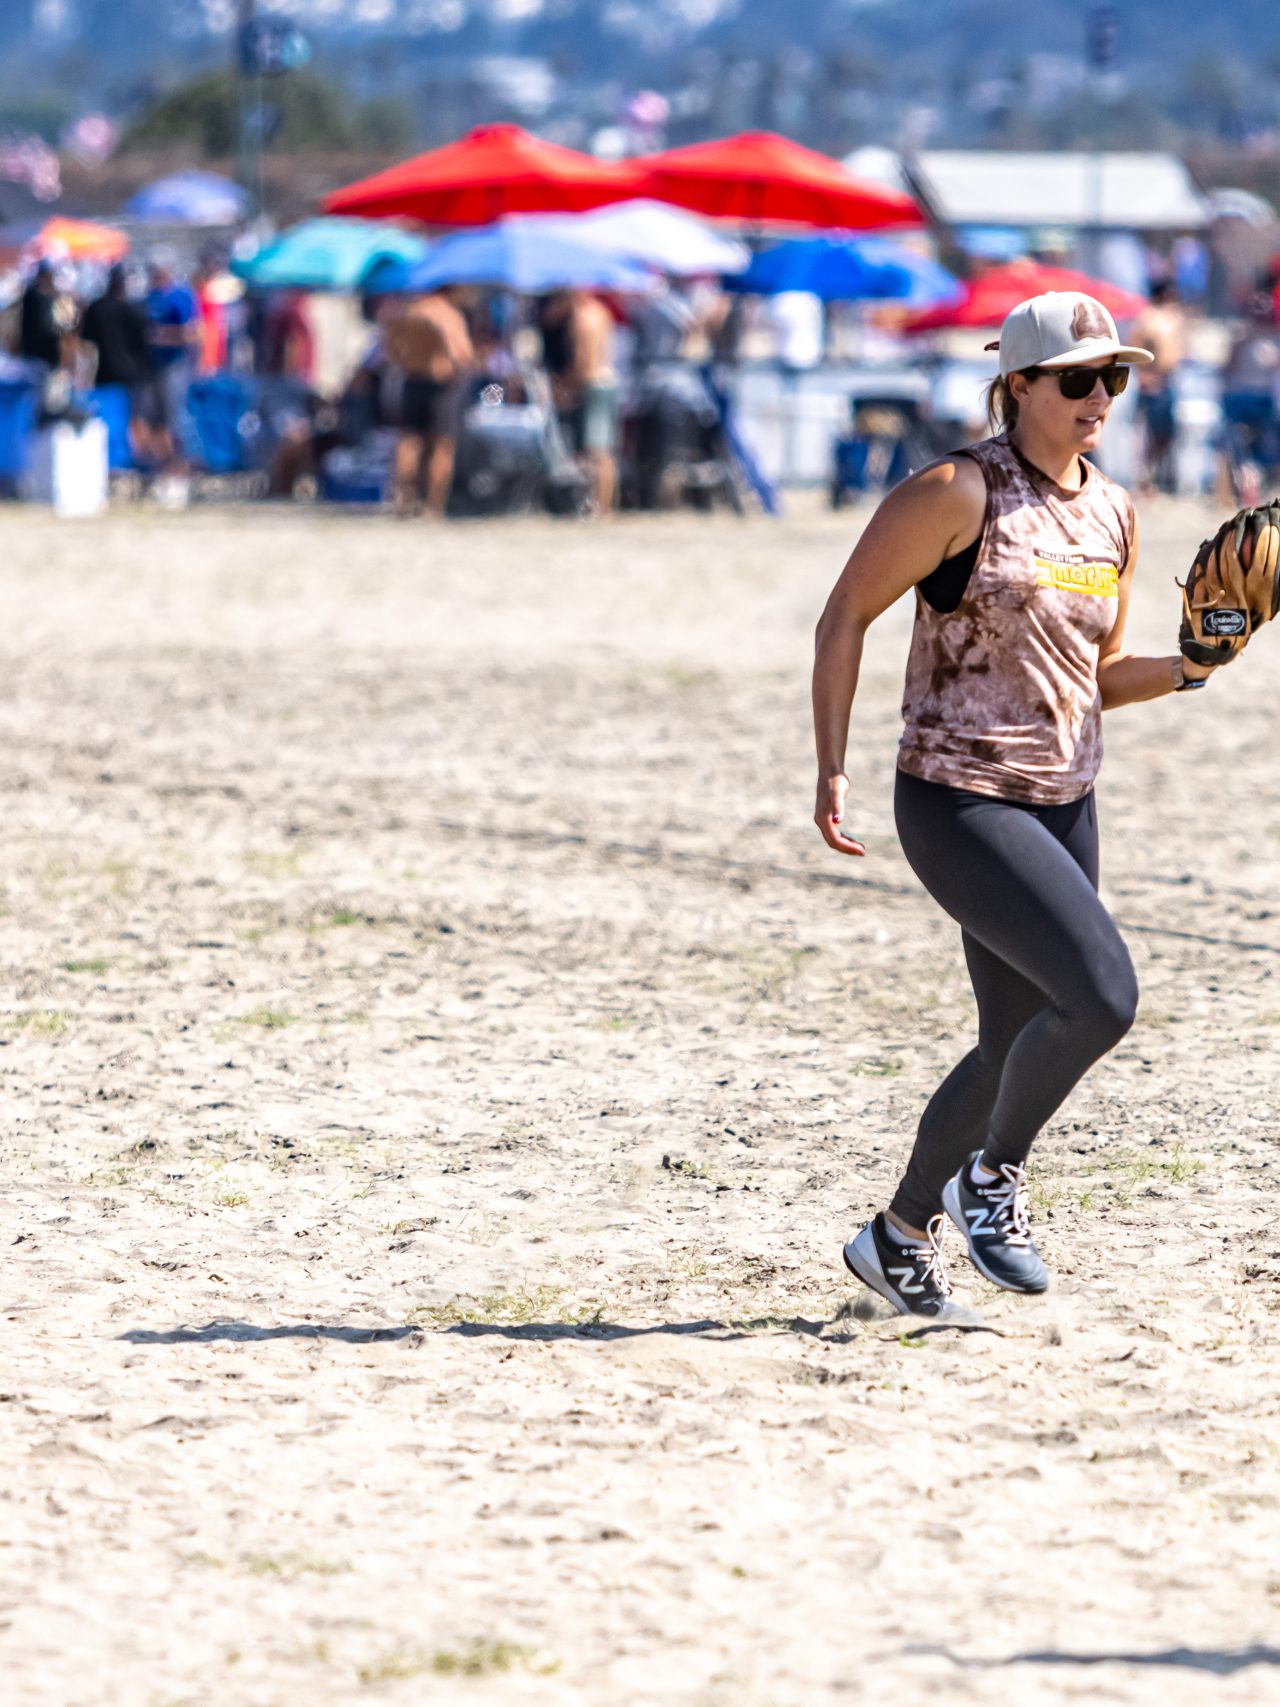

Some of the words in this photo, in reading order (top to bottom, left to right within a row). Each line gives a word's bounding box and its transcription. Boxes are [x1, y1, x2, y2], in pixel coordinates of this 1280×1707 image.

[1050, 563, 1119, 589] marke
[965, 1208, 996, 1236] N
[886, 1266, 926, 1295] N
